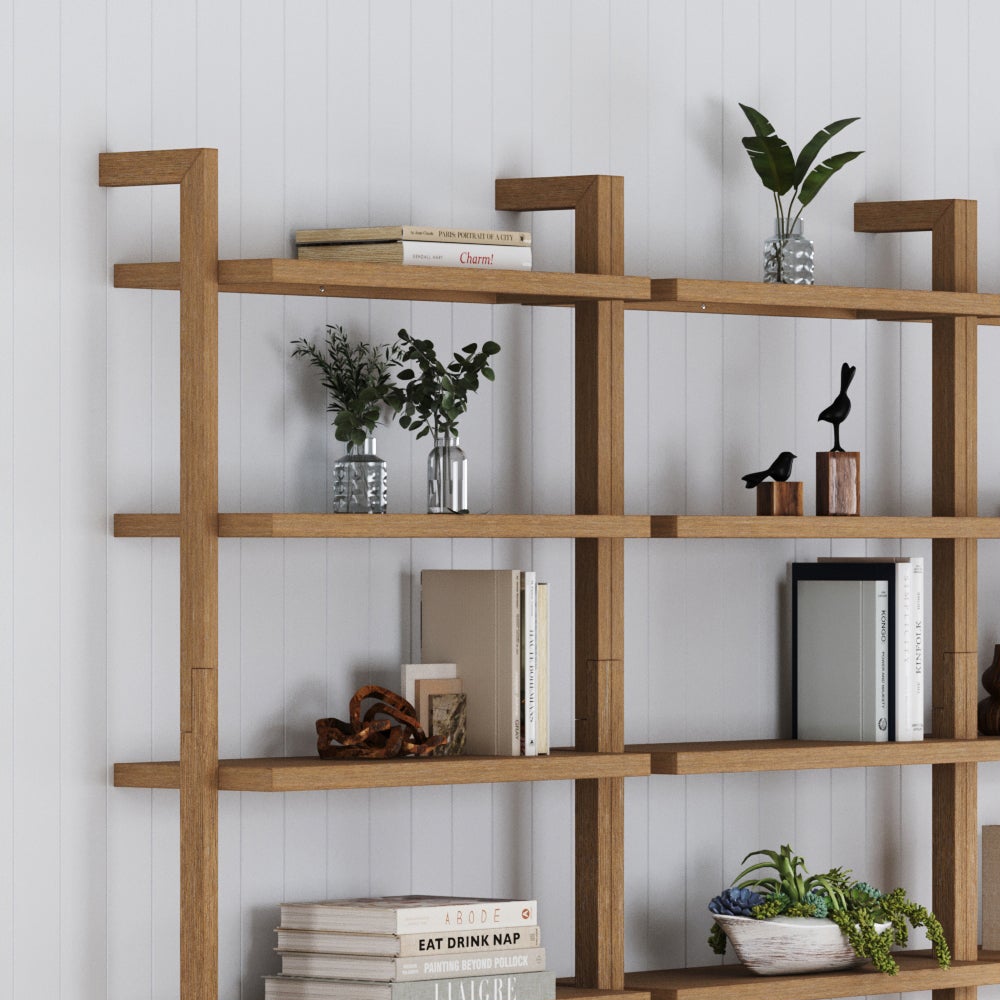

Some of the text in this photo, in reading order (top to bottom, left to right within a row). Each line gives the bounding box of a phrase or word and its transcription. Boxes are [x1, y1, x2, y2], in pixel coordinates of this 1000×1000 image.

[460, 251, 494, 265] Charm!
[445, 908, 501, 925] ABODE
[419, 932, 521, 951] EAT DRINK NAP
[424, 961, 460, 974] PAINTING
[461, 958, 493, 971] BEYOND
[494, 955, 529, 968] POLLOCK
